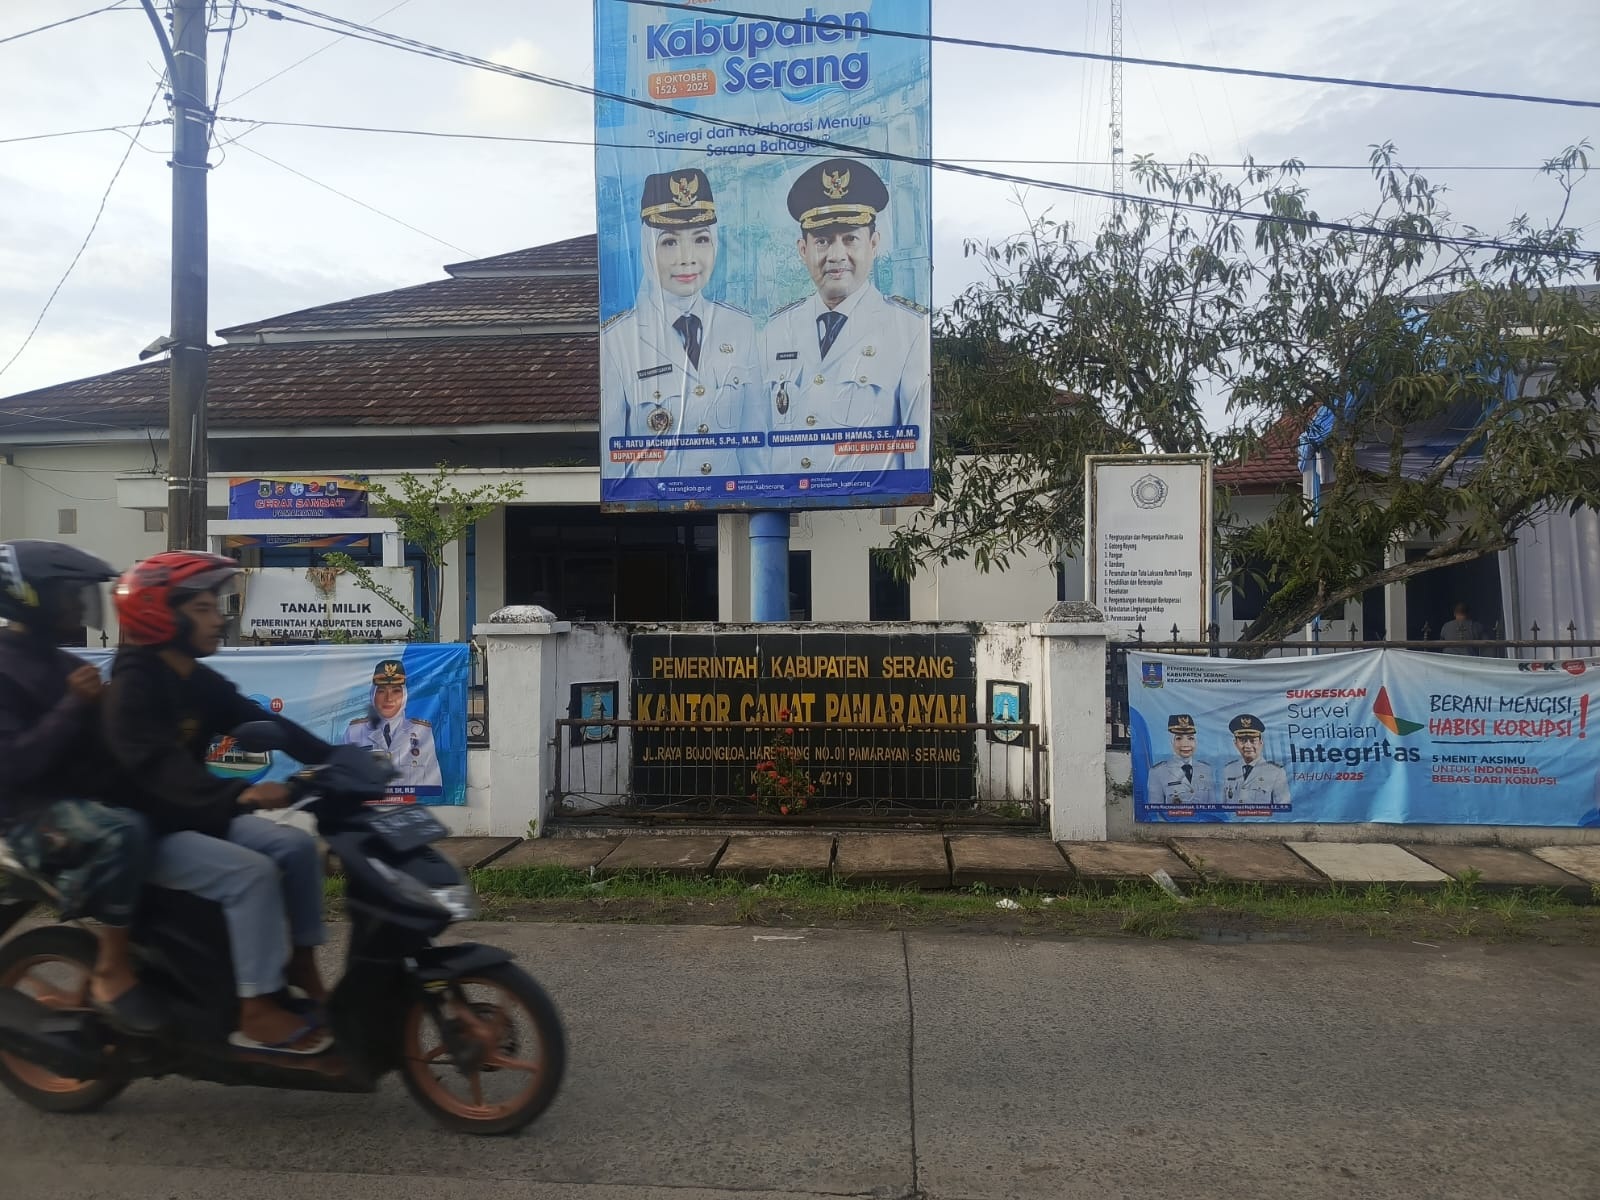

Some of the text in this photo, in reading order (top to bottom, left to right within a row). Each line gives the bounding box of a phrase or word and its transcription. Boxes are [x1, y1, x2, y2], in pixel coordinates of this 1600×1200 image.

[647, 8, 869, 60] Kabupaten
[723, 51, 869, 93] Serang
[656, 72, 708, 85] 8 OKTOBER
[656, 85, 677, 94] 1526
[686, 82, 709, 92] 2025
[707, 125, 734, 139] dan
[739, 118, 814, 138] Kolaborasi
[818, 115, 871, 131] Menuju
[706, 143, 756, 157] Serang
[773, 434, 818, 443] MUHAMMAD
[821, 432, 842, 441] NAJIB
[845, 431, 874, 441] HAMAS,
[626, 440, 644, 448] RATU
[839, 442, 914, 452] WAKIL BUPATI SERANG
[613, 451, 662, 460] BUPATI SERANG
[255, 497, 345, 509] GERAI SAMSAT
[280, 603, 372, 613] TANAH MILIK
[250, 619, 403, 628] PEMERINTAH KABUPATEN SERANG
[653, 656, 954, 679] PEMERINTAH KABUPATEN SERANG
[1518, 662, 1556, 673] KPK
[1286, 688, 1367, 699] SUKSESKAN
[272, 700, 281, 709] th
[1429, 694, 1492, 713] BERANI
[637, 693, 967, 732] KANTOR CAMAT PAMARAYAN
[1287, 702, 1349, 719] Survei
[1288, 722, 1377, 739] Penilaian
[1429, 718, 1485, 736] HABISI
[1493, 718, 1573, 738] KORUPSI
[1290, 738, 1420, 767] Integritas
[1432, 755, 1526, 765] 5 MENIT AKSIMU
[1432, 764, 1539, 775] UNTUK INDONESIA
[1293, 772, 1364, 781] TAHUN 2025
[1432, 774, 1557, 785] BEBAS DARI KORUPSI
